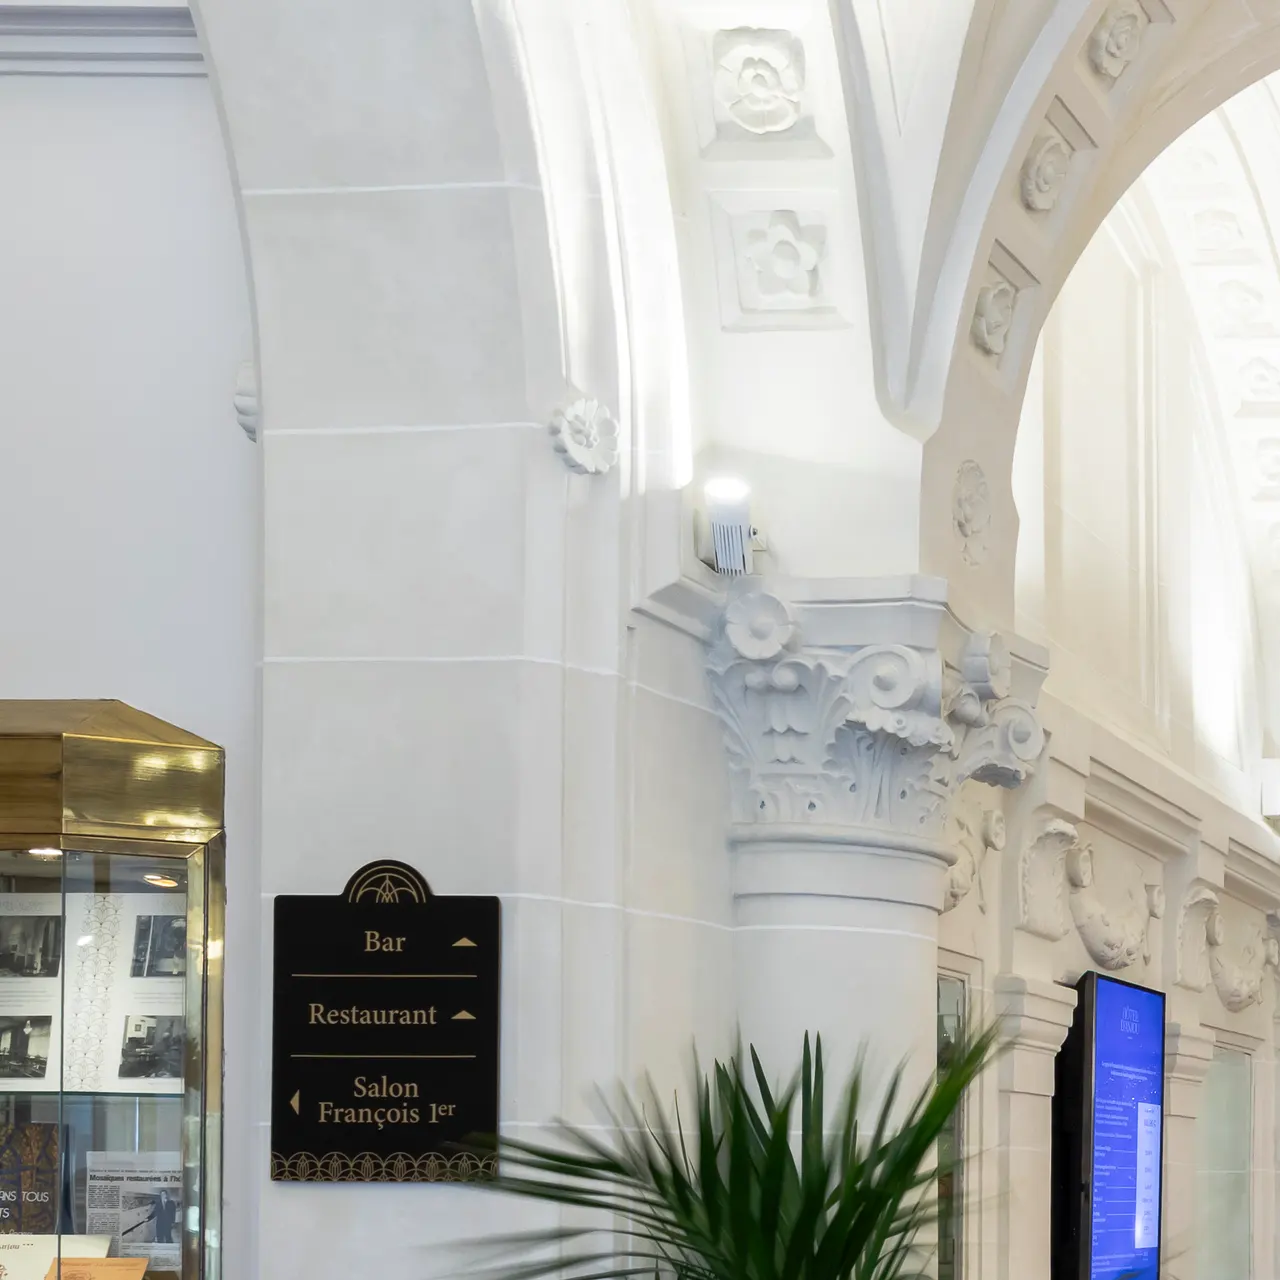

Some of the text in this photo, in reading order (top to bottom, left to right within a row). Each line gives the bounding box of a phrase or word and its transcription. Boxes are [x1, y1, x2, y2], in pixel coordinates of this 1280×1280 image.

[364, 930, 407, 952] Bar
[308, 1003, 437, 1025] Restaurant
[353, 1075, 419, 1098] Salon
[318, 1101, 420, 1130] François
[21, 1191, 49, 1203] TOUS
